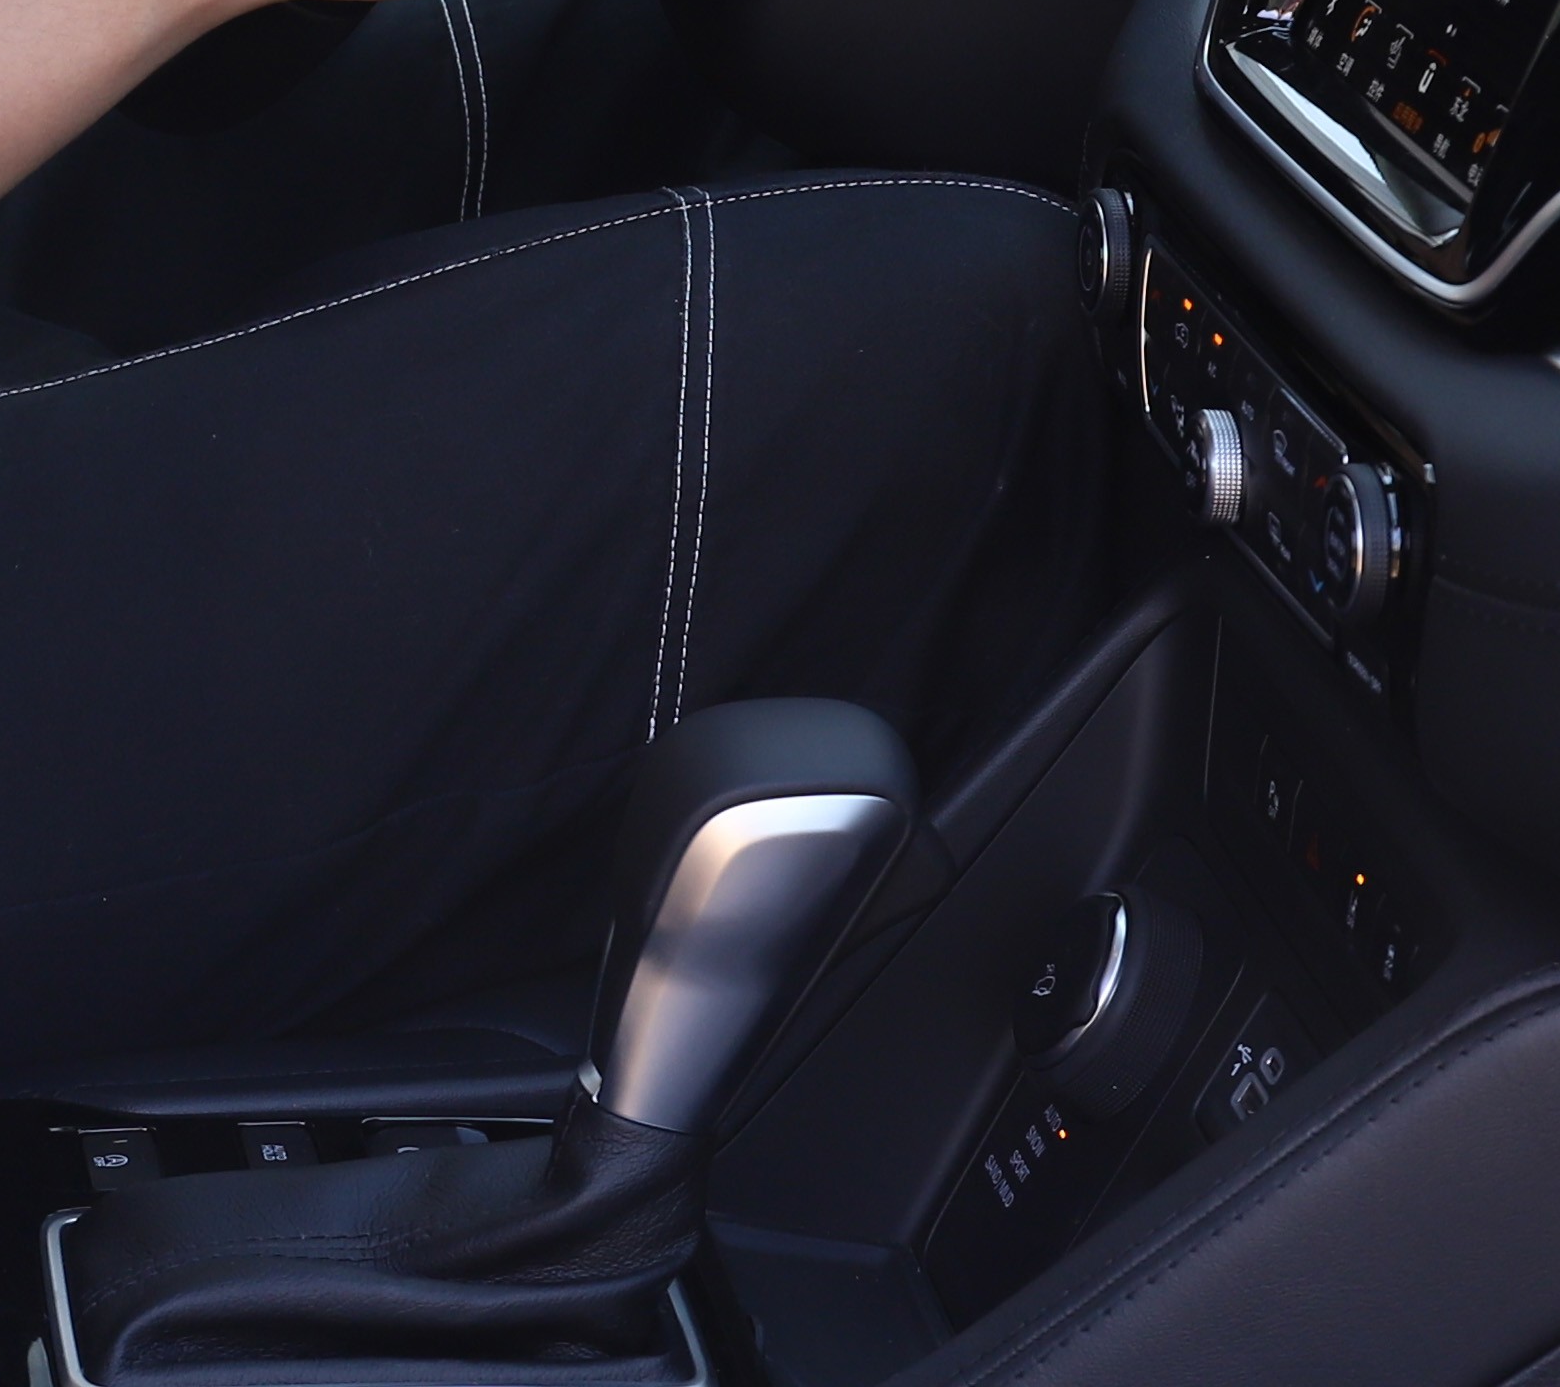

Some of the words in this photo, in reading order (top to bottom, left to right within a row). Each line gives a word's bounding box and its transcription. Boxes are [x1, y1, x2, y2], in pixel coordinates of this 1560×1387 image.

[1337, 51, 1354, 77] 空调
[1043, 1104, 1062, 1132] AUTO
[1025, 1124, 1047, 1158] SNOW
[1010, 1149, 1030, 1183] SPORT
